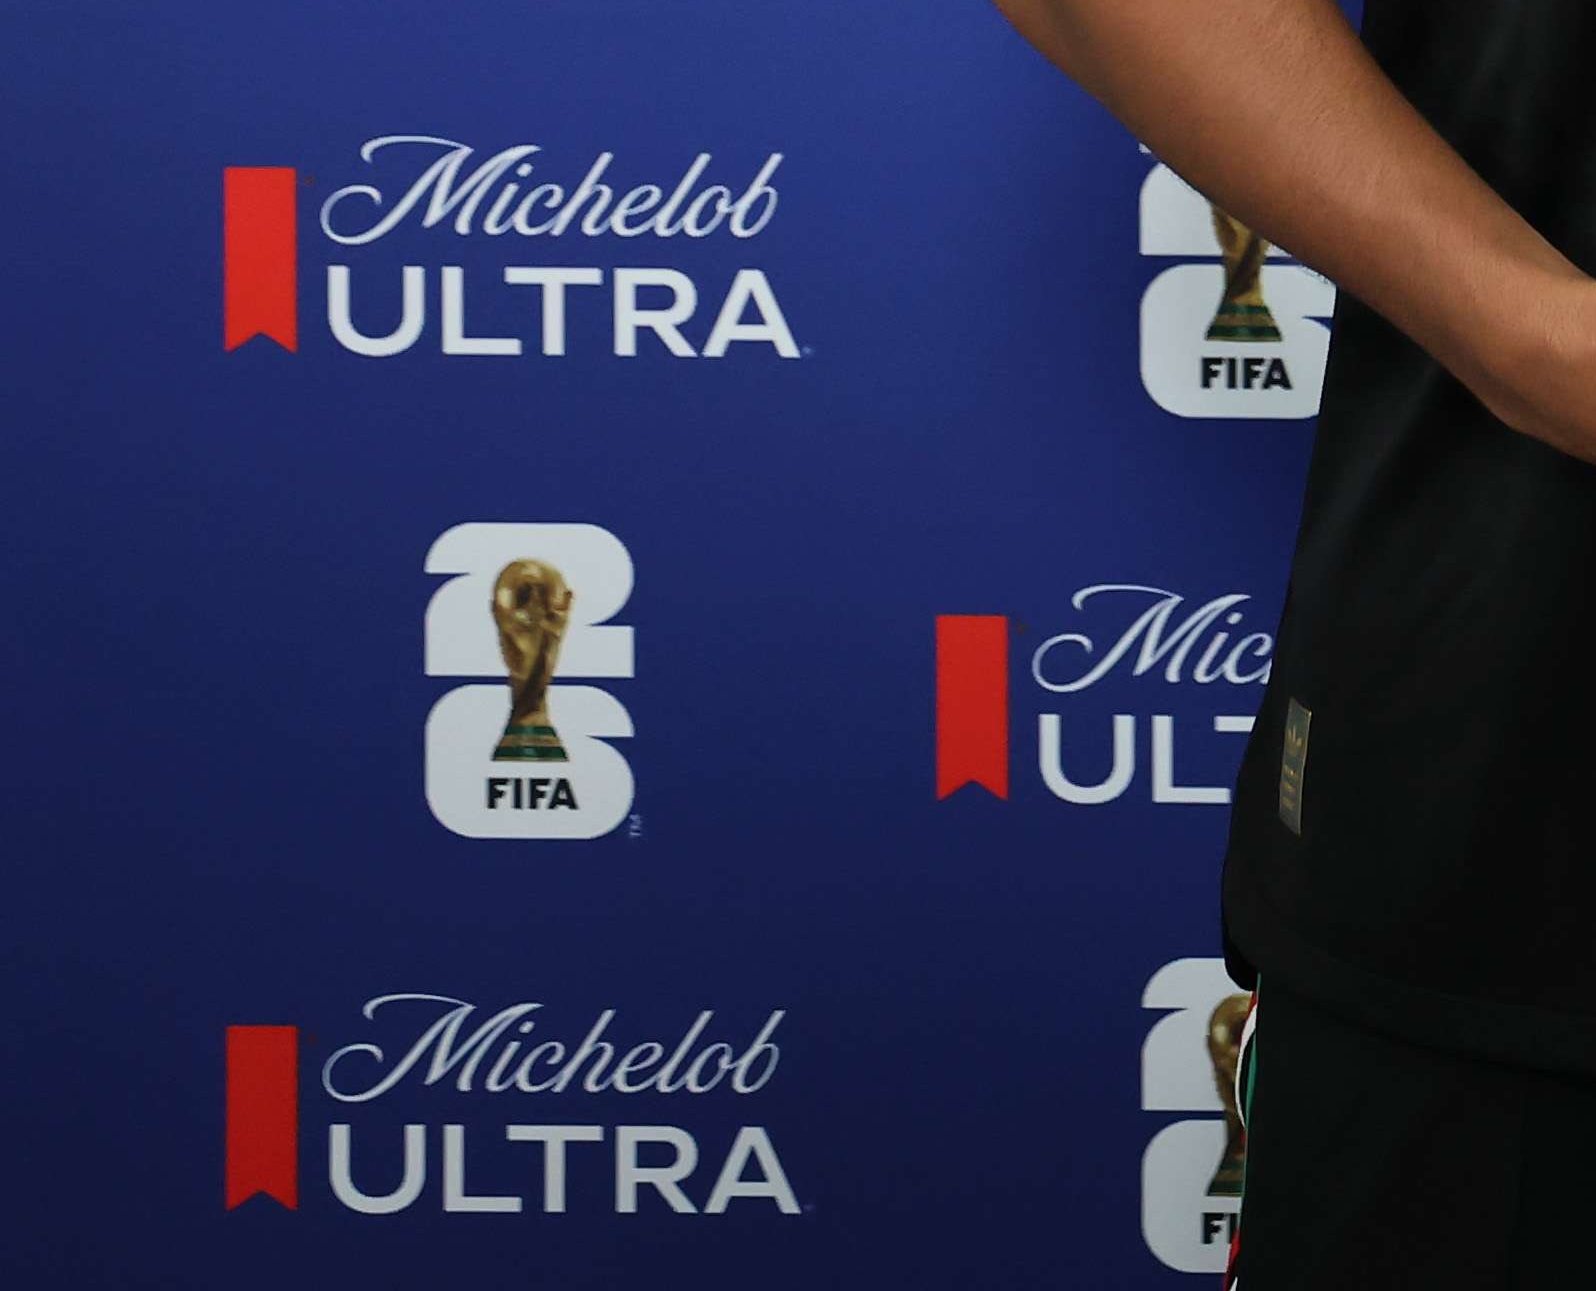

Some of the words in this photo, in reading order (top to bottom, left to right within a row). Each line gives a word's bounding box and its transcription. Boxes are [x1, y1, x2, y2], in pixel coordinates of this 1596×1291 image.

[320, 136, 783, 244] Michelob
[328, 266, 800, 358] ULTRA
[1201, 356, 1292, 390] FIFA
[487, 777, 578, 810] FIFA
[323, 994, 785, 1102] Michelob
[329, 1124, 801, 1214] ULTRA
